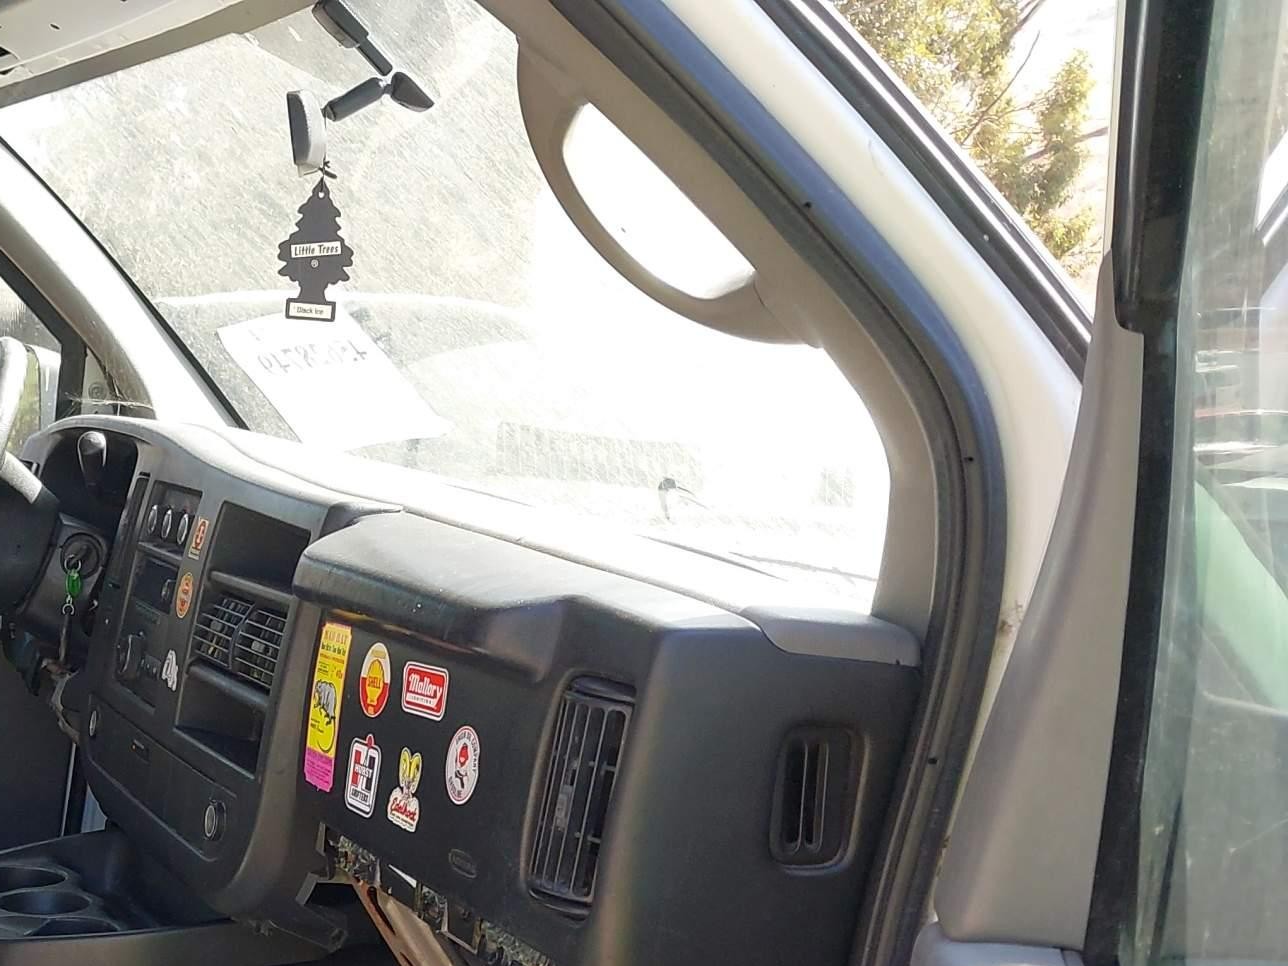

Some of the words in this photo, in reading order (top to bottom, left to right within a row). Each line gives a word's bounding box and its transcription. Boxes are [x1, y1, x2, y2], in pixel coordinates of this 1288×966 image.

[294, 245, 316, 257] Little
[317, 243, 339, 255] Trees
[367, 675, 381, 689] SHELL
[408, 672, 443, 704] Mallory
[354, 764, 373, 779] HURST
